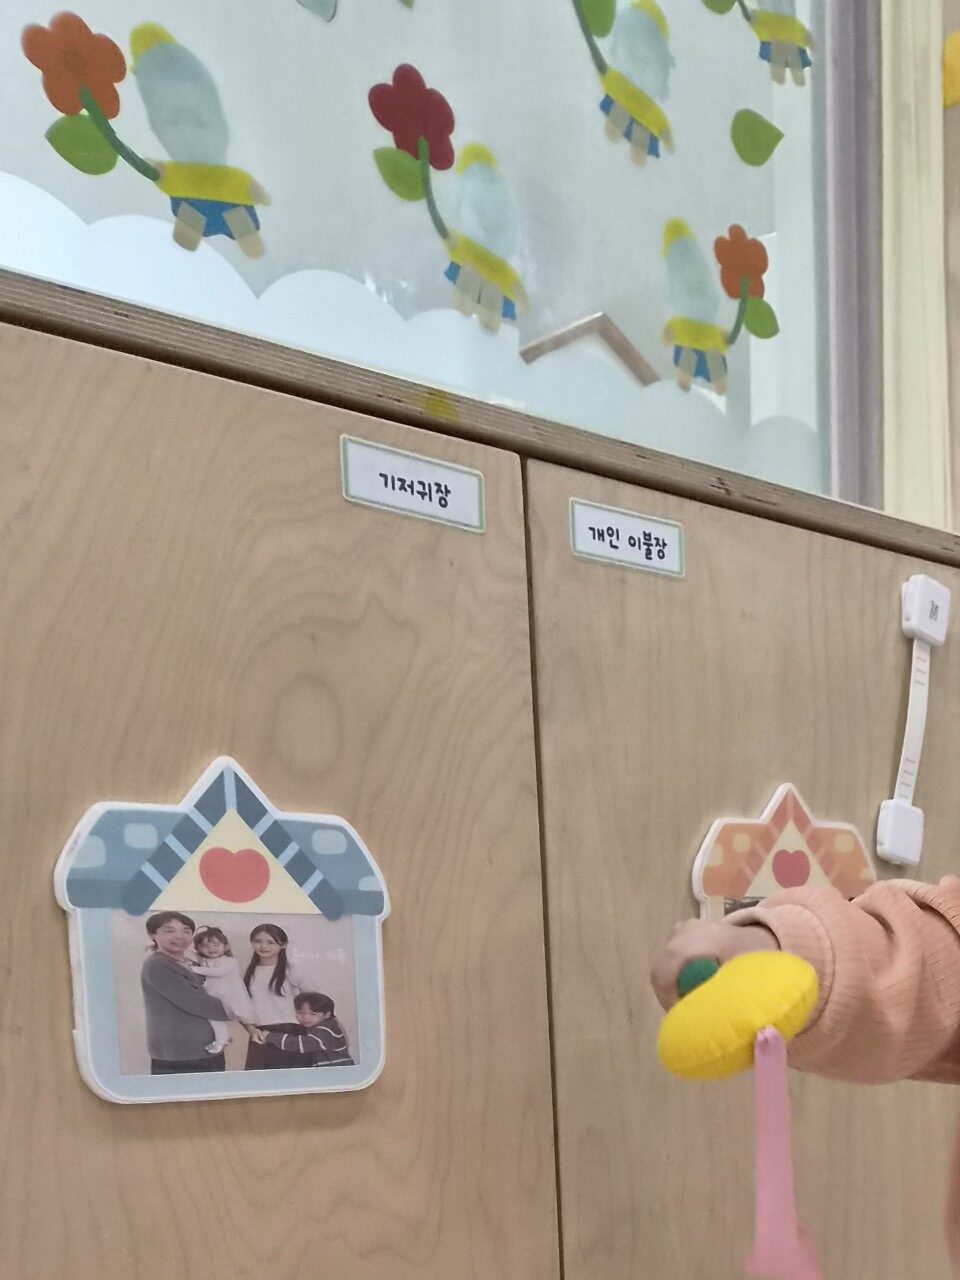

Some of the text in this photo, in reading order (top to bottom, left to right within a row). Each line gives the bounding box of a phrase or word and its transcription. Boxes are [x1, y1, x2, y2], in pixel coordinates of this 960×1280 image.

[378, 472, 451, 508] 기저귀장
[588, 526, 668, 561] 개인 이불장
